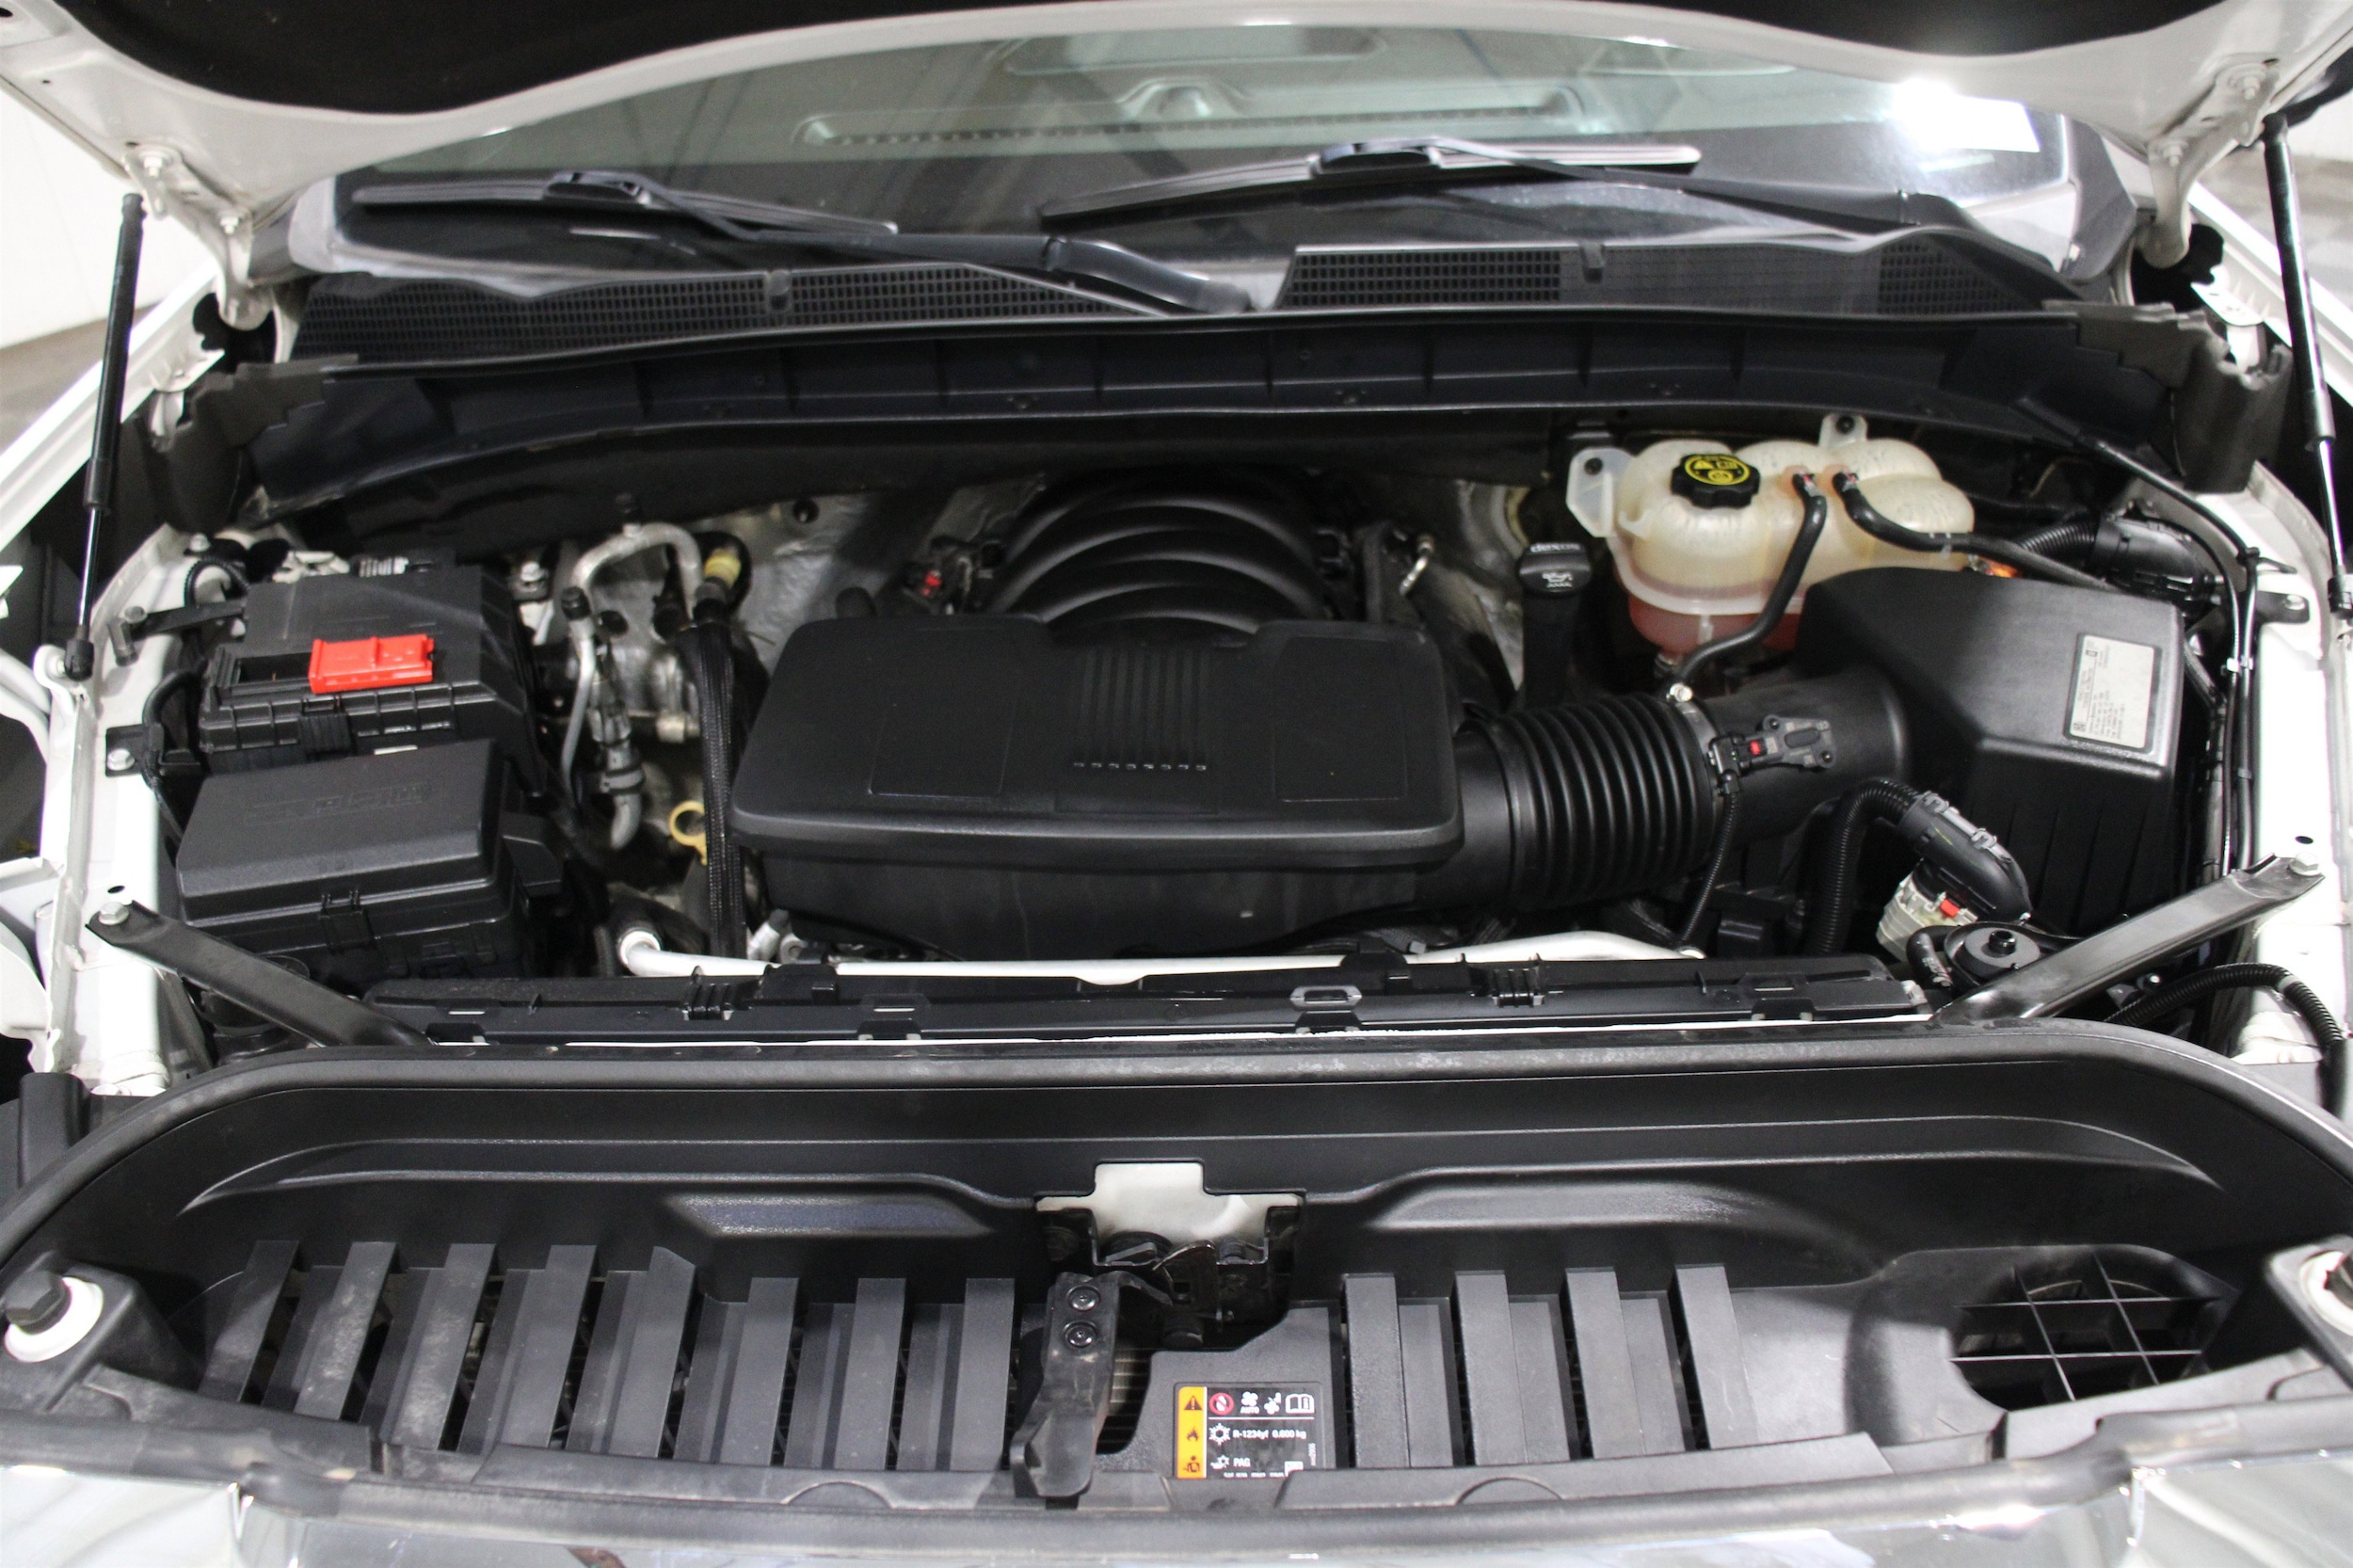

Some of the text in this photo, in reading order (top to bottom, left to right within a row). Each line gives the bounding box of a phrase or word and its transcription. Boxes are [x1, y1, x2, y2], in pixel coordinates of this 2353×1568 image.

[1530, 542, 1580, 552] dexos
[1232, 1429, 1269, 1439] R-1234yf
[1296, 1429, 1306, 1439] kg
[1233, 1458, 1251, 1467] PAG
